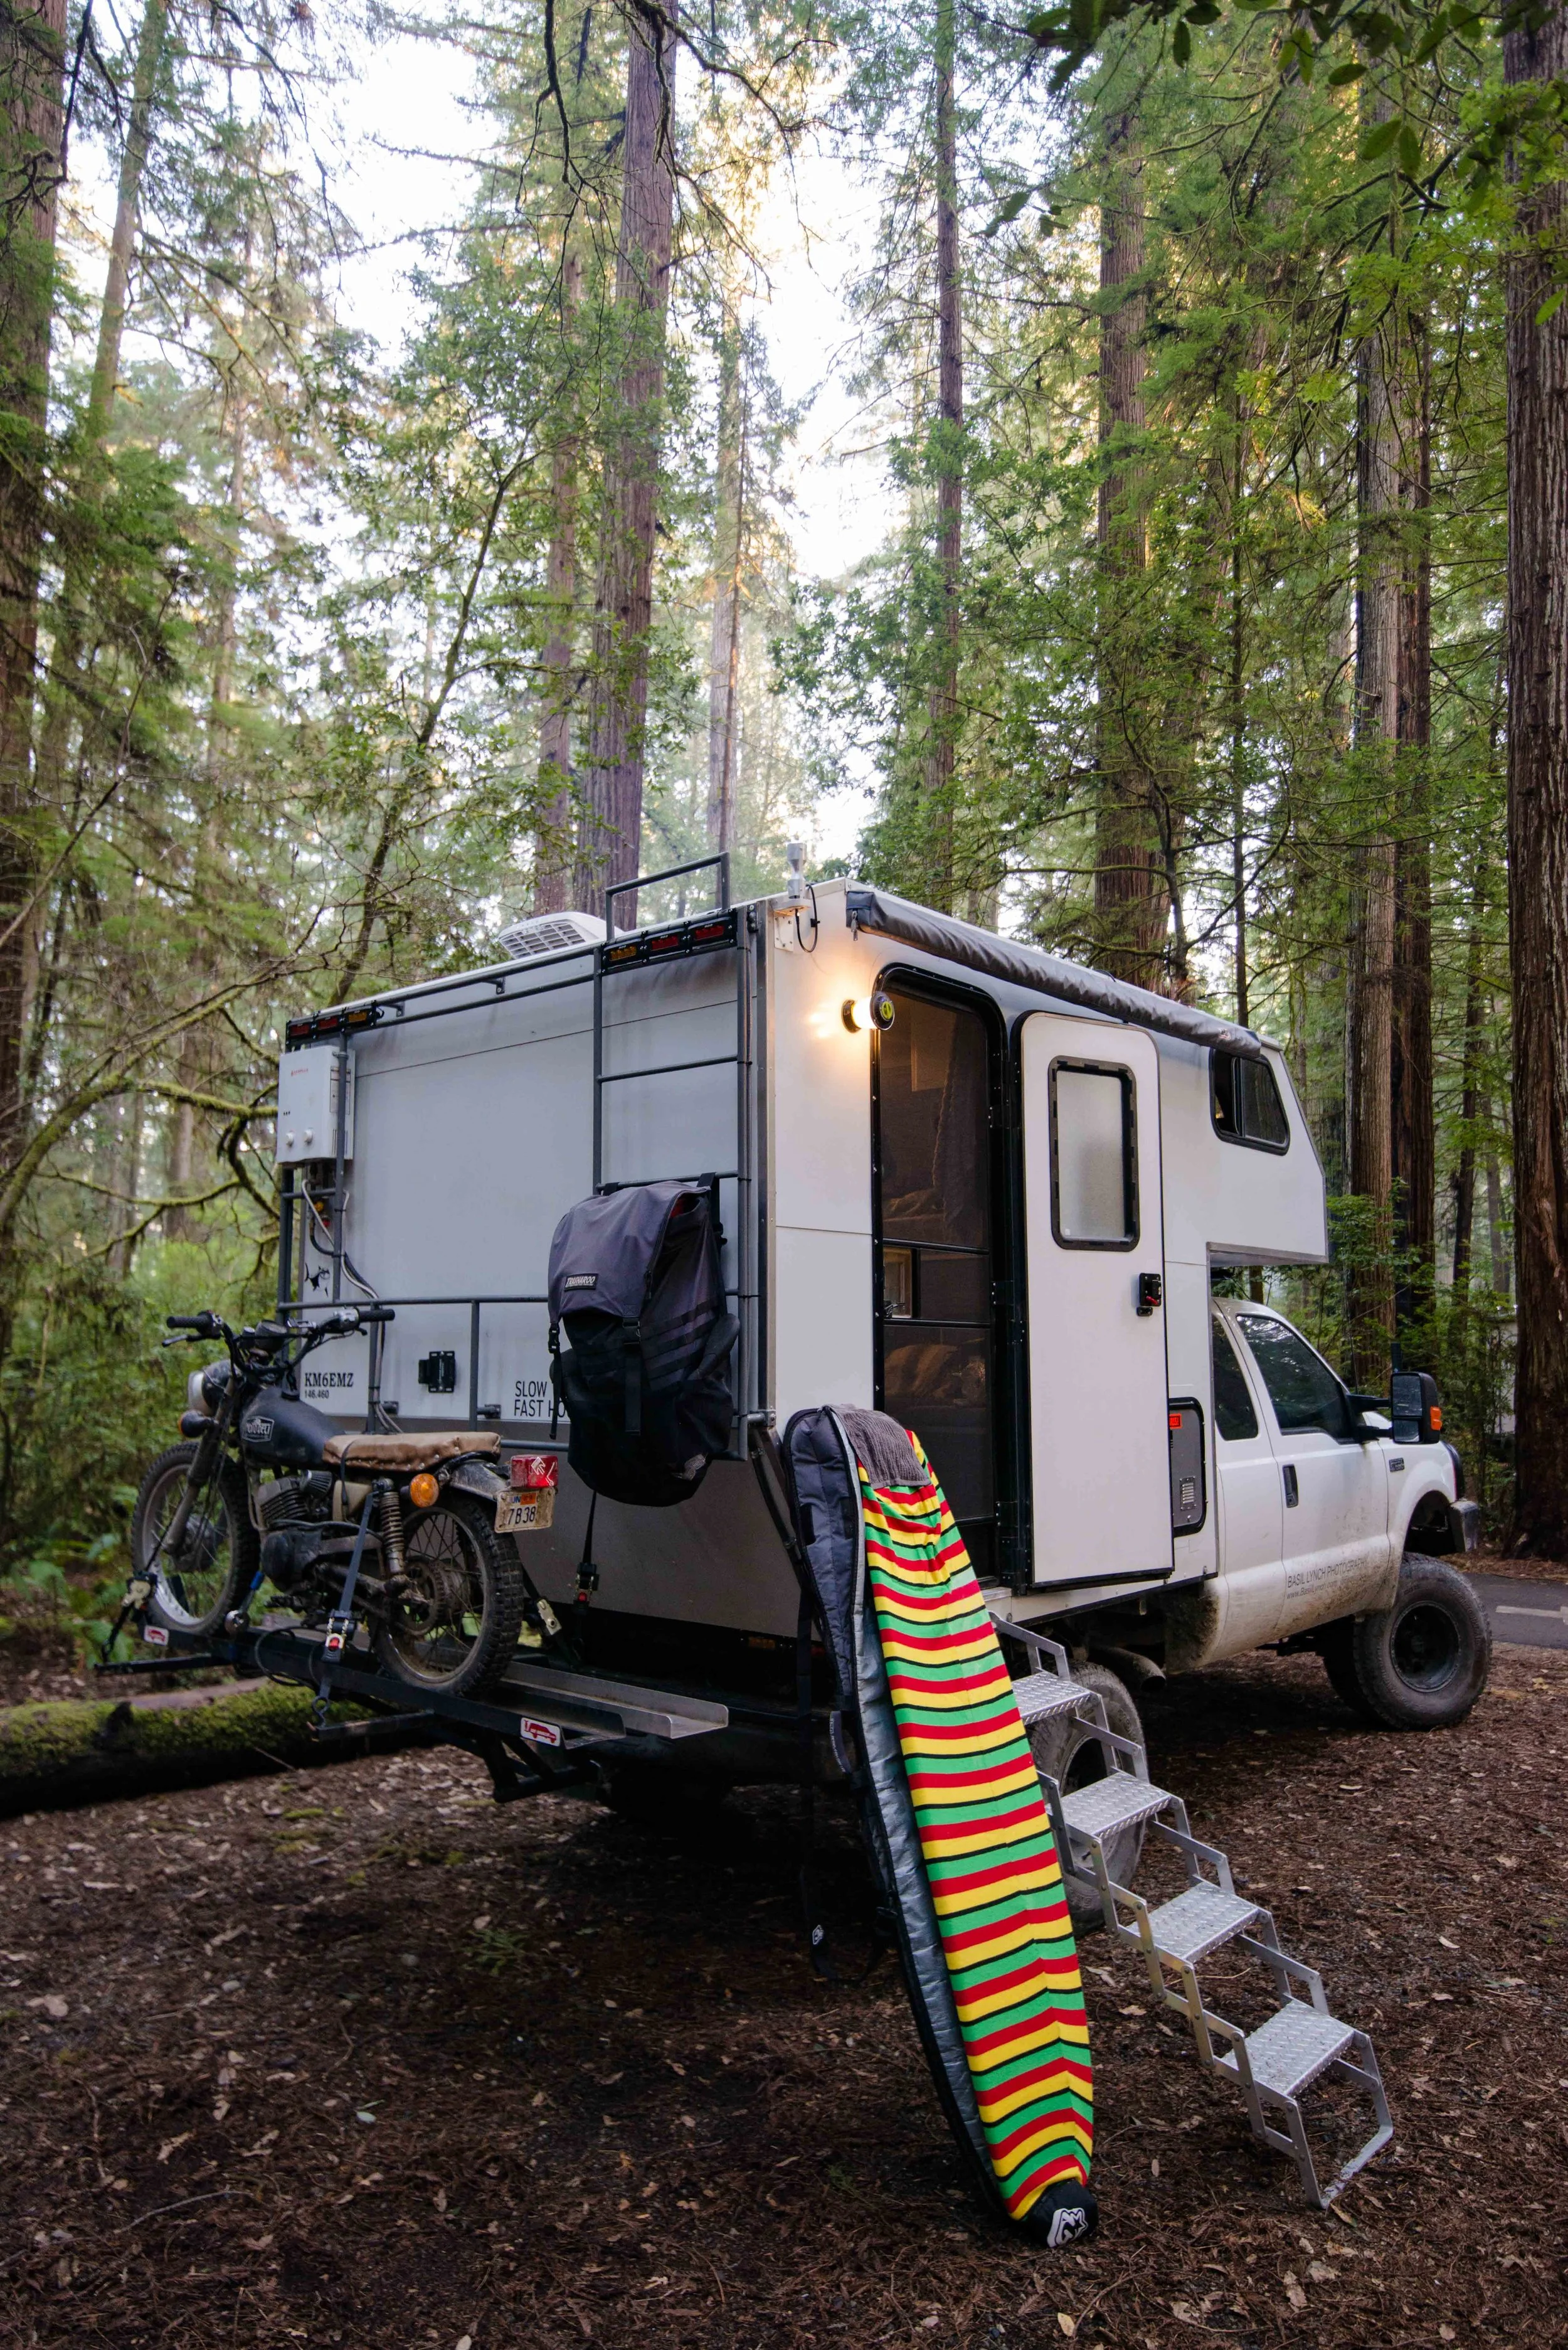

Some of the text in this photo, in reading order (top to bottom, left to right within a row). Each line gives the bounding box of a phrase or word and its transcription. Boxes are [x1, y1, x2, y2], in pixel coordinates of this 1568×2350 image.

[305, 1372, 354, 1388] KM6EMZ
[515, 1381, 547, 1398] SLOW
[514, 1399, 544, 1417] FAST
[1288, 1572, 1305, 1588] BASIL
[1306, 1568, 1325, 1583] LYNCH
